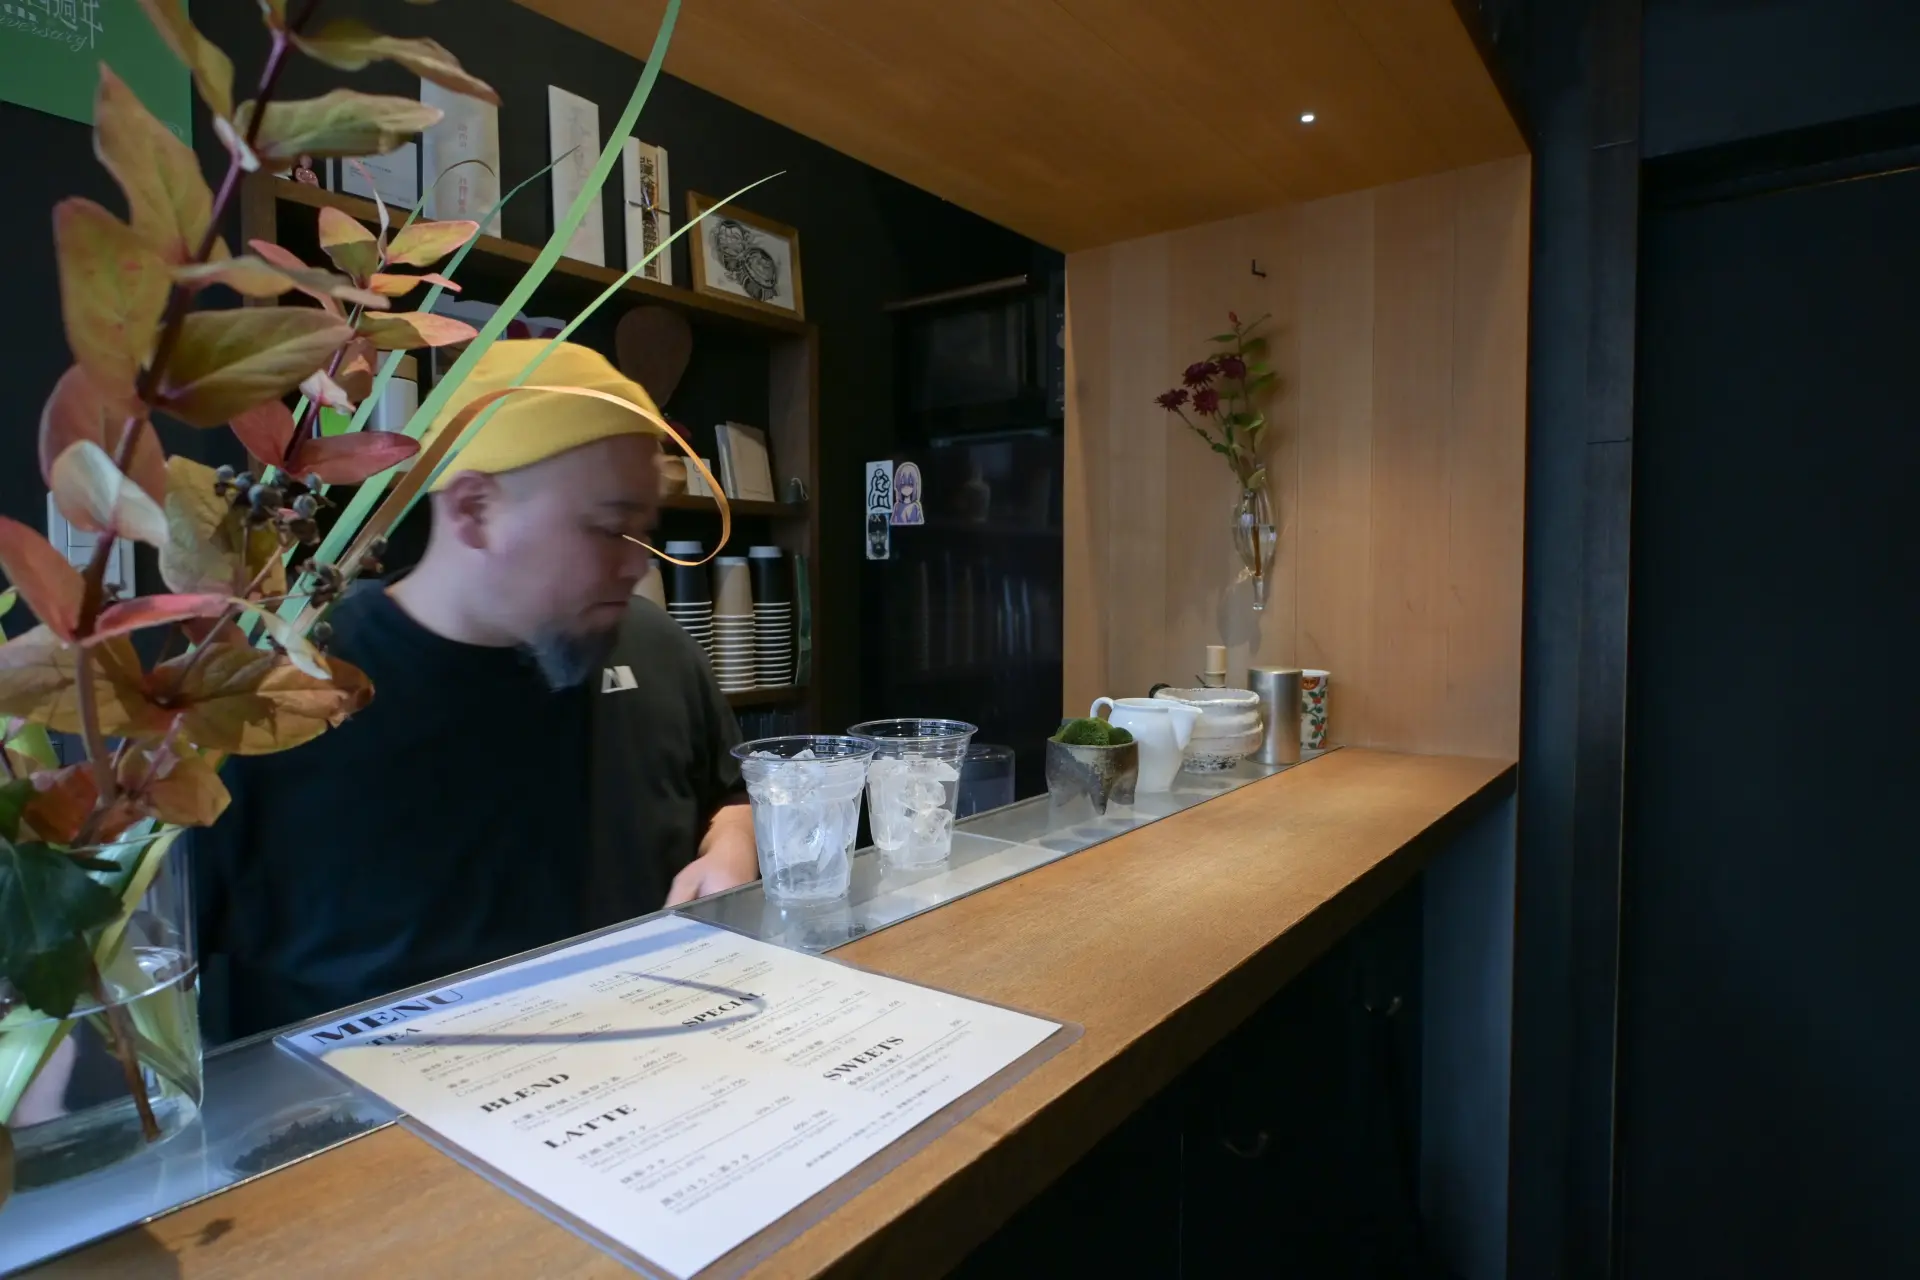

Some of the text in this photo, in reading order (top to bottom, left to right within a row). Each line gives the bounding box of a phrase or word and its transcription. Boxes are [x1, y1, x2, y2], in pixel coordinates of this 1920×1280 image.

[310, 988, 464, 1045] MENU
[681, 992, 766, 1028] SPECIAL
[365, 1028, 422, 1047] TEA
[823, 1036, 904, 1081] SWEETS
[479, 1073, 570, 1114] BLEND
[543, 1104, 637, 1149] LATTE
